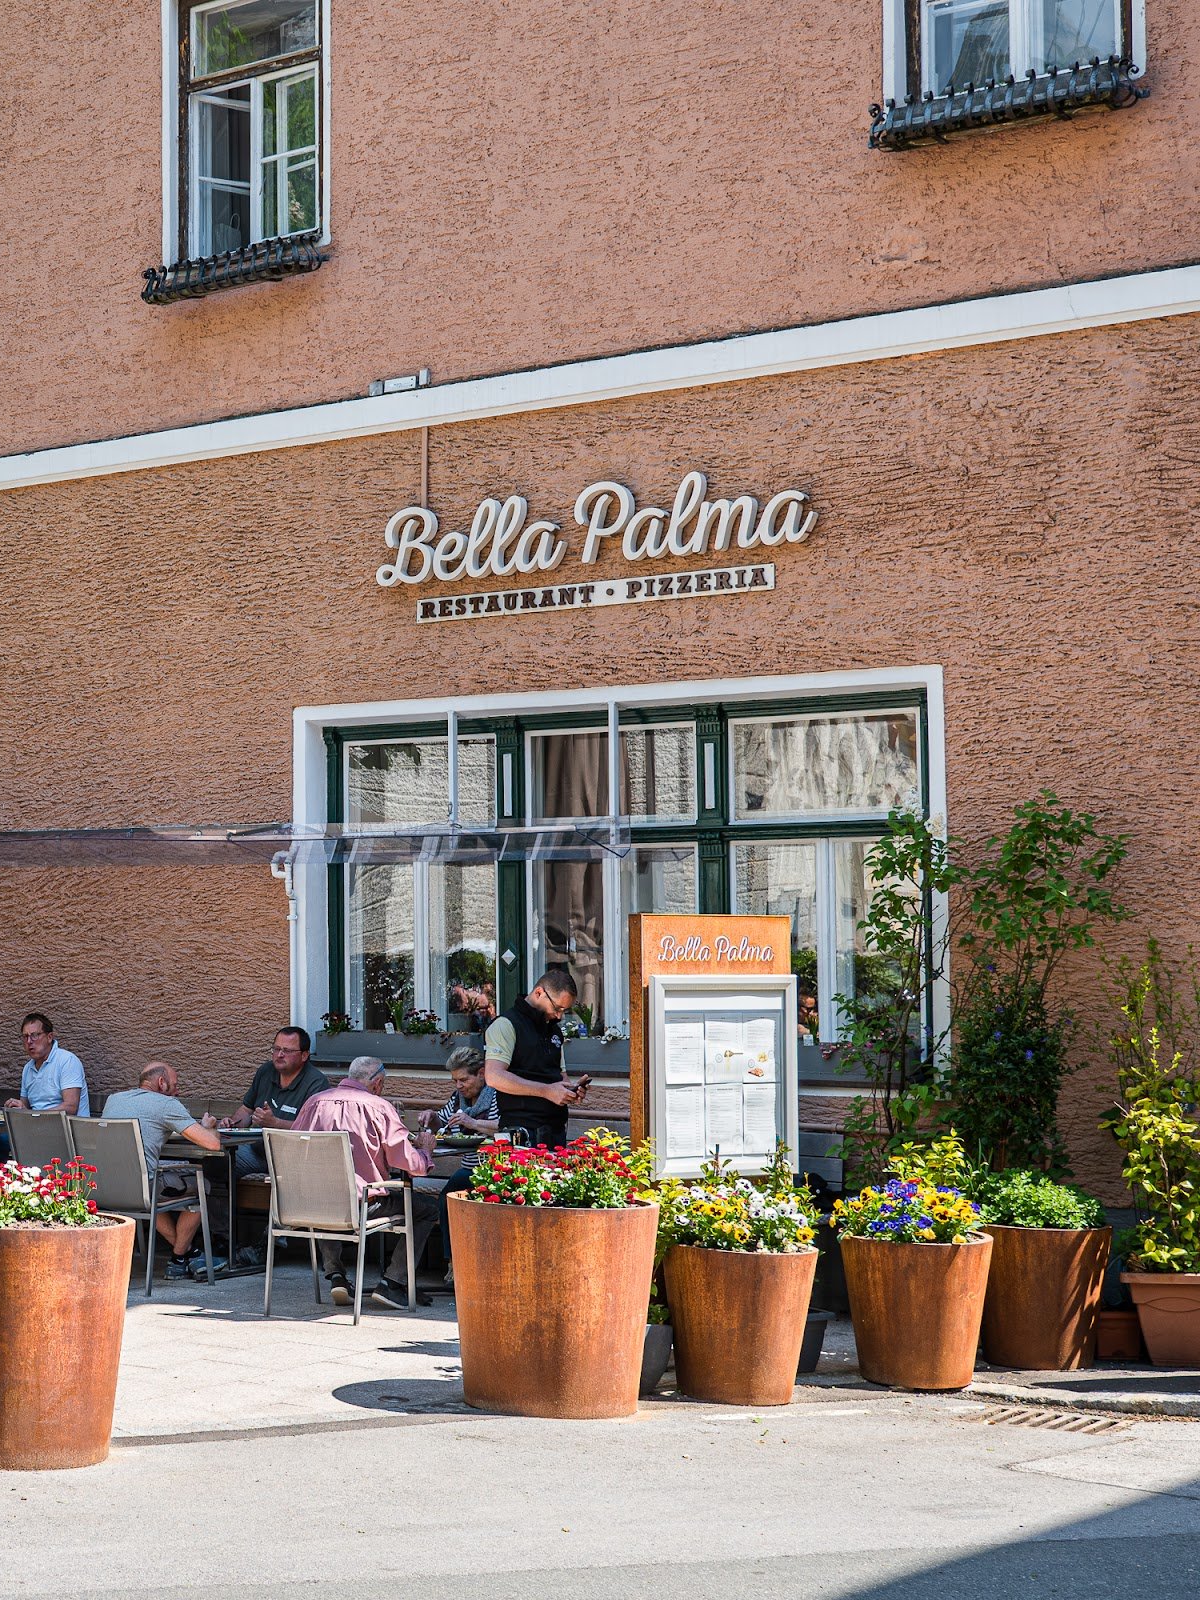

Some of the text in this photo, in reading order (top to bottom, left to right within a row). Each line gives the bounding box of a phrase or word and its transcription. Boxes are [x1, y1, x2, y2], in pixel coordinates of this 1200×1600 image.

[376, 471, 819, 587] Bella Palma
[419, 567, 768, 619] RESTAURANT PIZZERIA
[658, 935, 774, 962] Bella Palma
